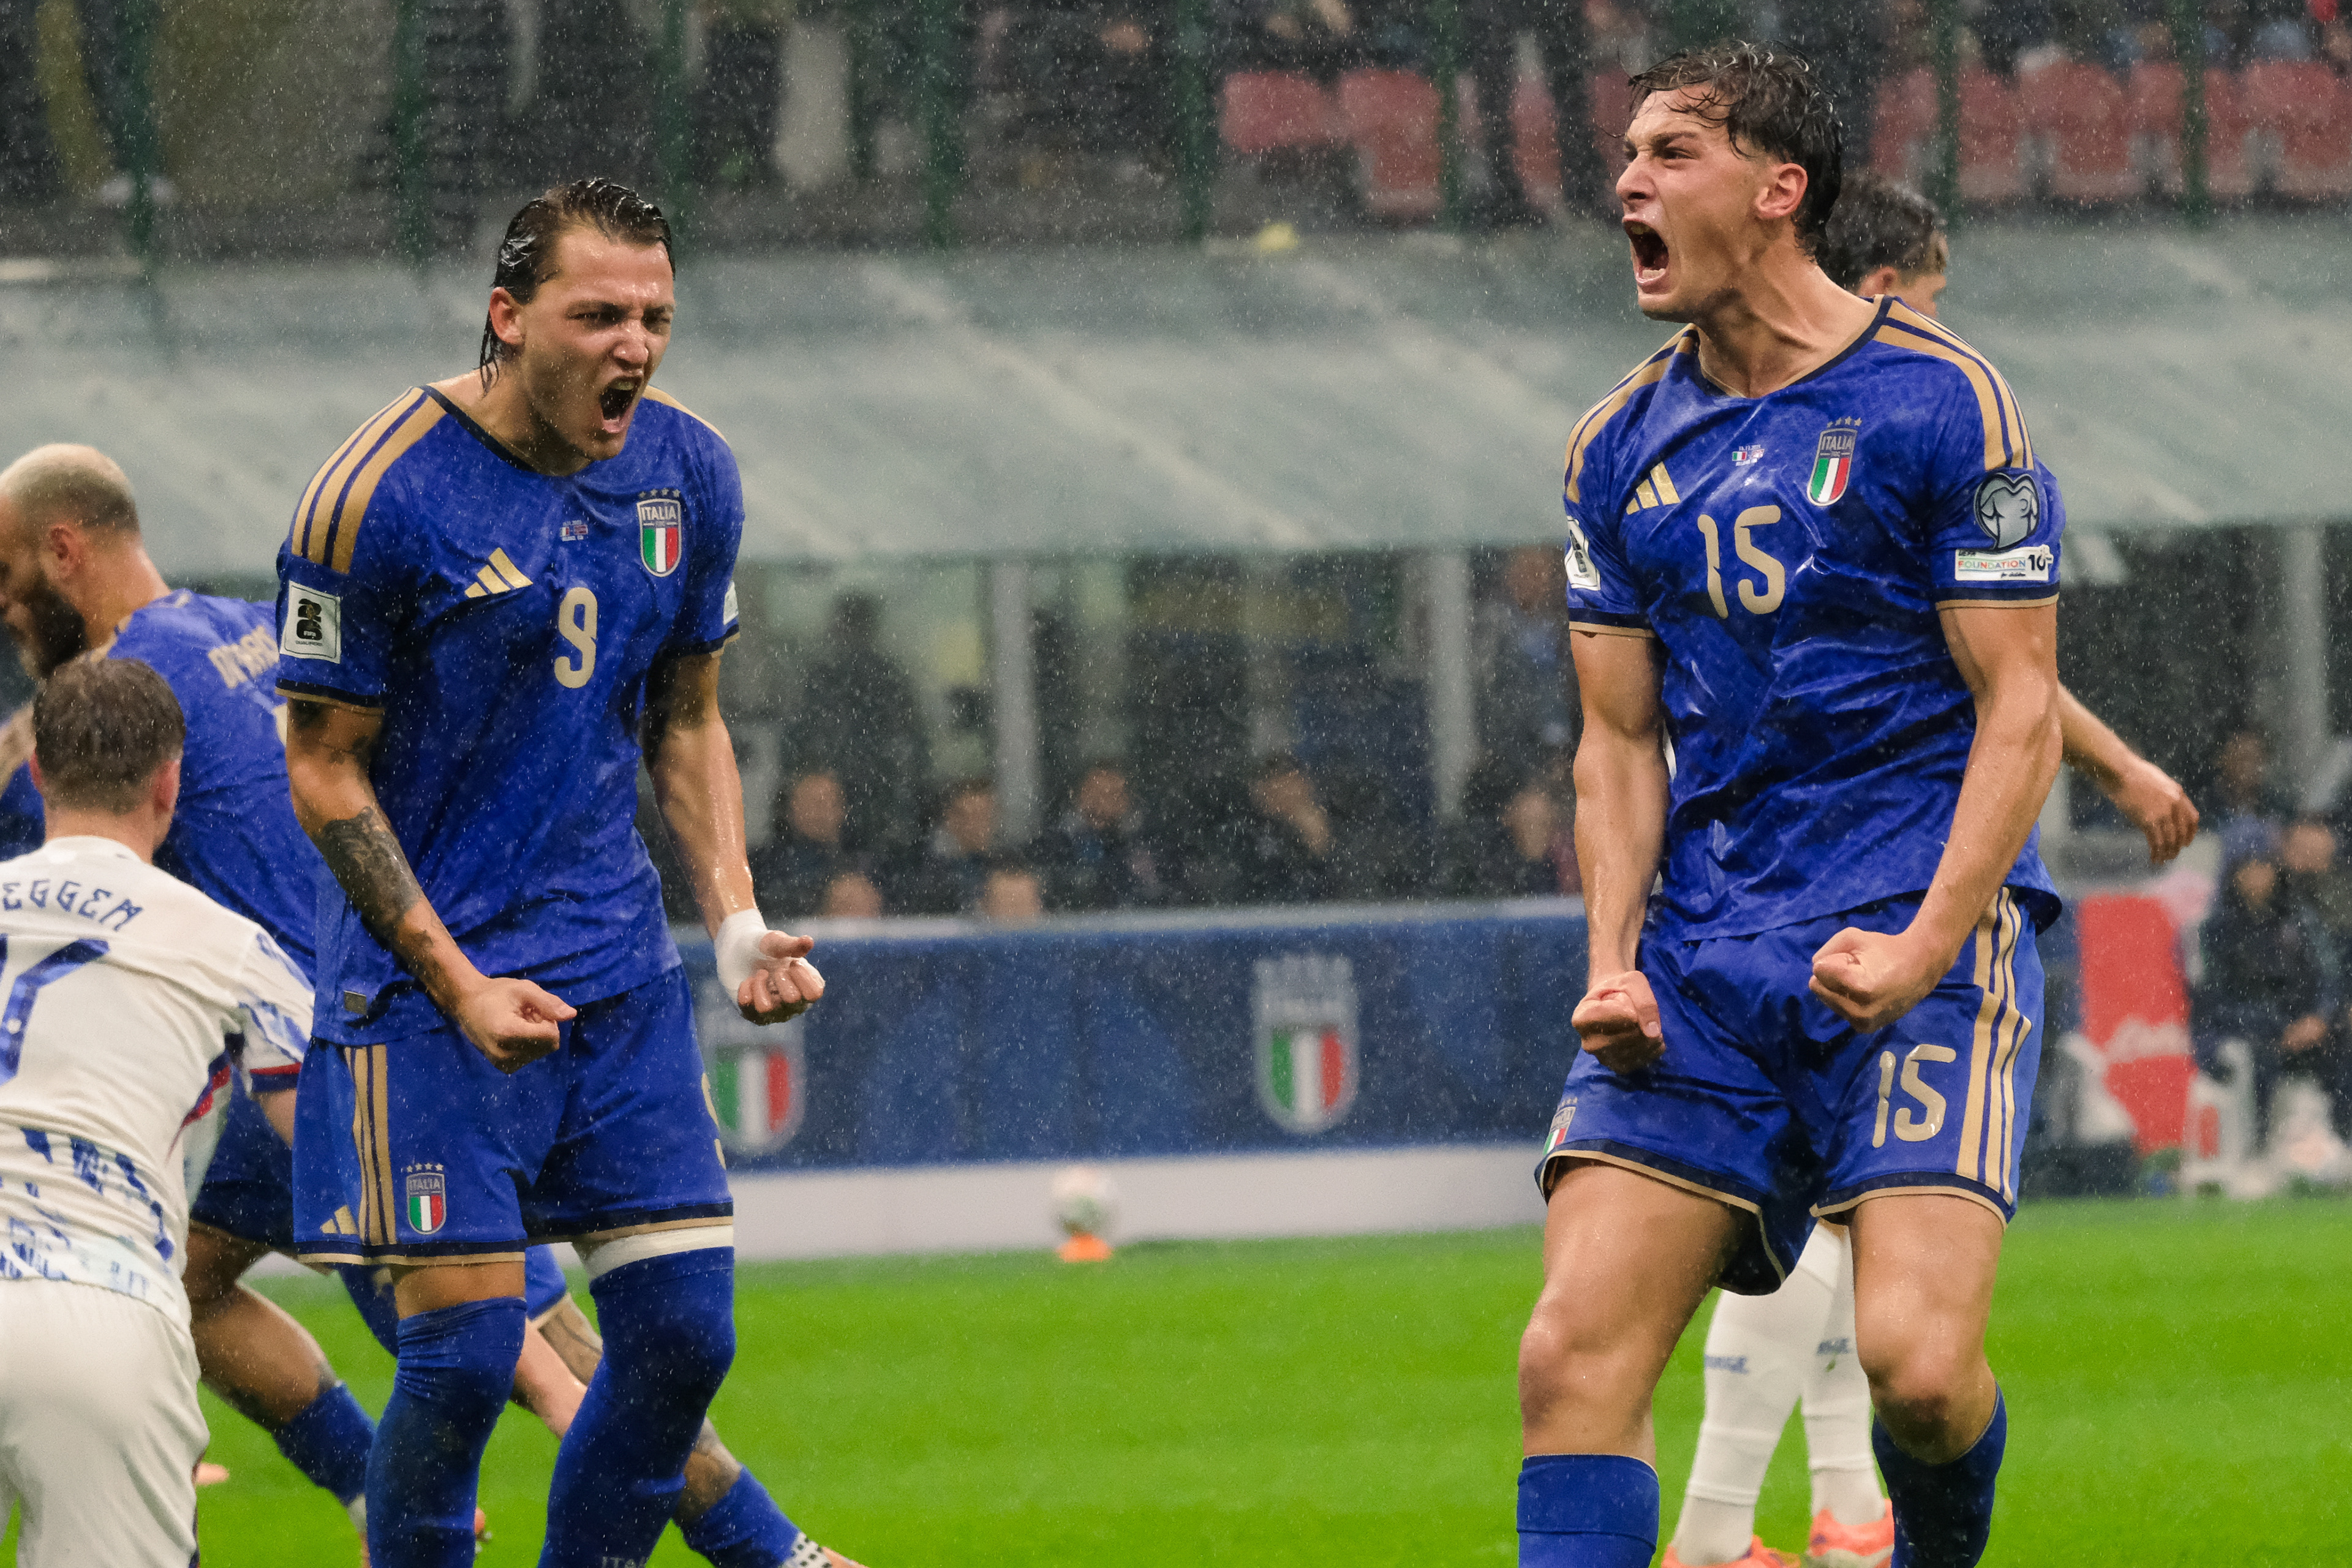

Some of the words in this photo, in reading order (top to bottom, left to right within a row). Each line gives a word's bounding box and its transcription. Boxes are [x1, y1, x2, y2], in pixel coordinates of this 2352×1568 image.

[1820, 435, 1853, 450] ITALIA
[640, 505, 677, 521] ITALIA
[1697, 505, 1785, 619] 15
[1958, 560, 2026, 569] FOUNDATION
[554, 587, 598, 688] 9
[1872, 1044, 1956, 1148] 15
[409, 1177, 441, 1191] ITALIA
